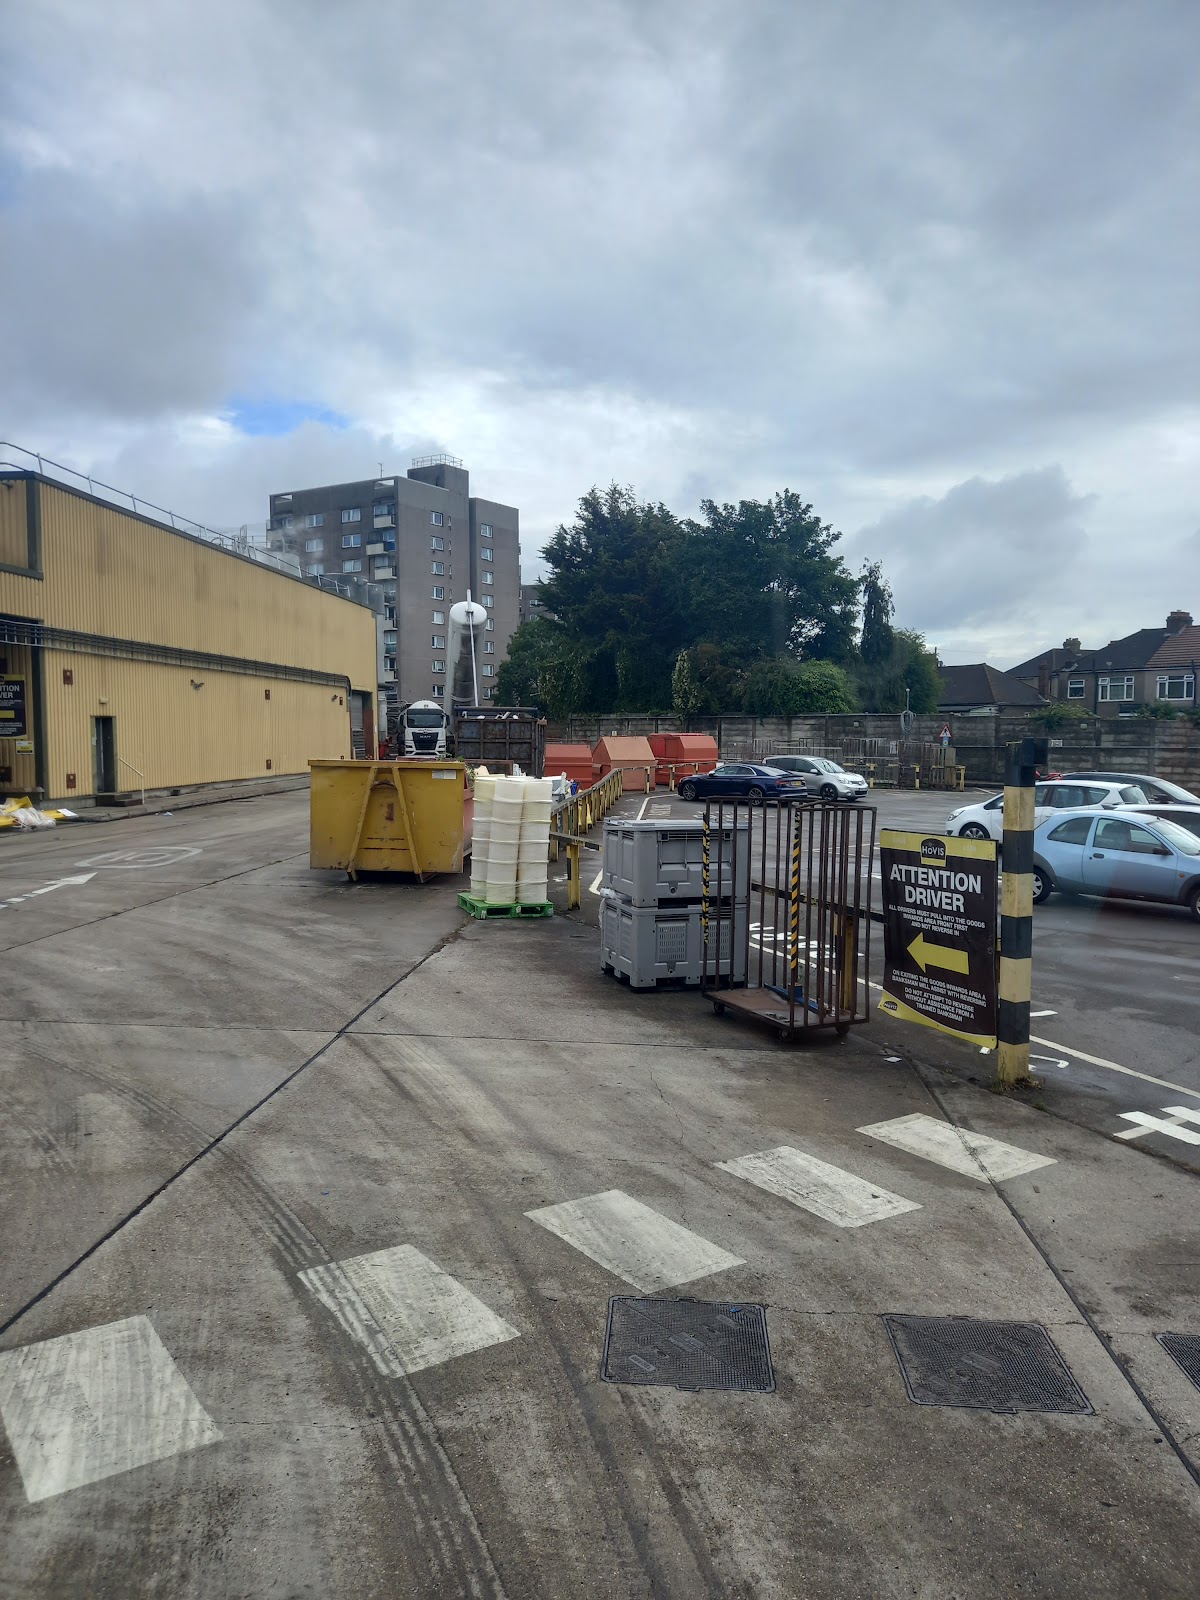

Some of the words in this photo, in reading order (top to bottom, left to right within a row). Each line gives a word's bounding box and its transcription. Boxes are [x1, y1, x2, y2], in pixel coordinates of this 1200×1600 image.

[890, 864, 981, 894] ATTENTION
[905, 885, 964, 912] DRIVER
[897, 906, 916, 914] DRIVERS
[966, 920, 985, 928] GOODS
[903, 913, 923, 922] INWARDS
[932, 925, 953, 935] REVERSE
[892, 975, 918, 986] BANKSMAN
[931, 986, 946, 994] ASSIST
[947, 990, 959, 998] WITH
[960, 993, 986, 1007] REVERSING
[901, 971, 918, 980] EXITING
[929, 979, 946, 988] GOODS
[946, 983, 968, 994] INWARDS
[969, 990, 981, 999] AREA
[905, 994, 926, 1003] WITHOUT
[927, 1000, 955, 1013] ASSISTANCE
[956, 1008, 969, 1017] FROM
[916, 1002, 936, 1013] TRAINED
[937, 1008, 962, 1022] BANKSMAN
[923, 992, 944, 1002] ATTEMPT
[953, 1001, 974, 1012] REVERSE
